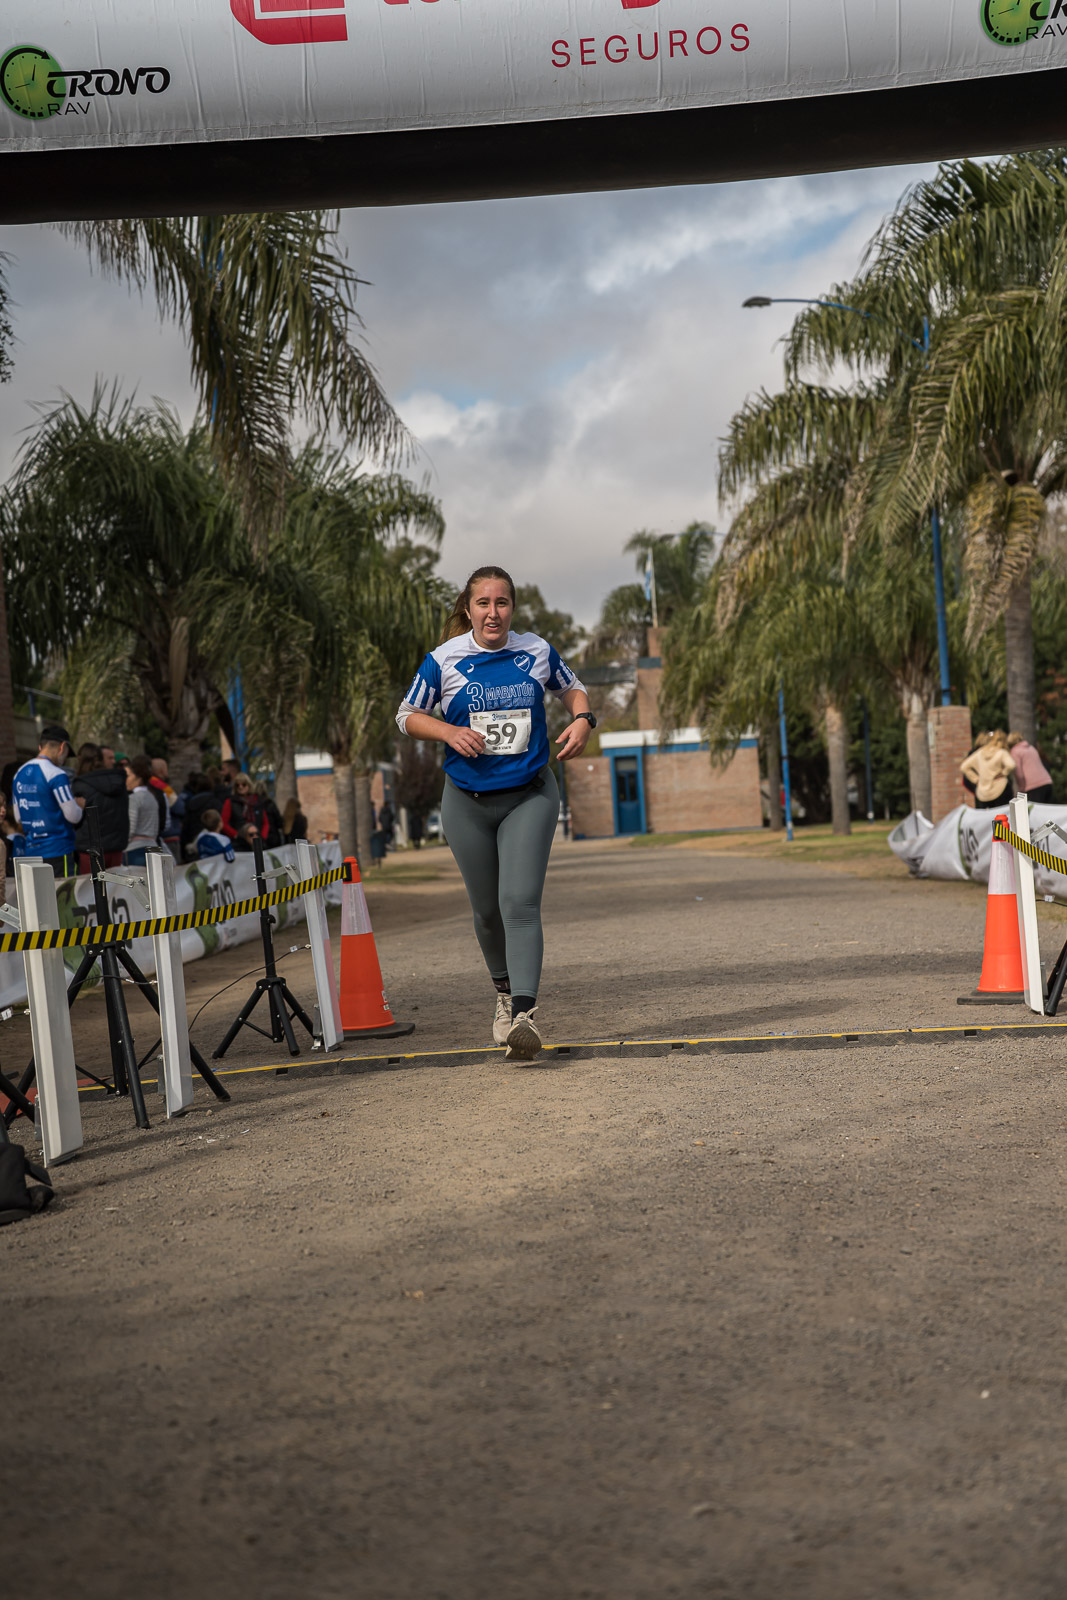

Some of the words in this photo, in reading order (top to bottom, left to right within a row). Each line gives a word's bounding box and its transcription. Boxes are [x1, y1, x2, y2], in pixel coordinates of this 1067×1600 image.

[551, 23, 750, 68] SEGUROS
[46, 67, 171, 98] CRONO
[47, 101, 91, 117] RAV
[466, 682, 486, 712] 3
[485, 681, 535, 701] MARATÓN
[486, 722, 517, 745] 59
